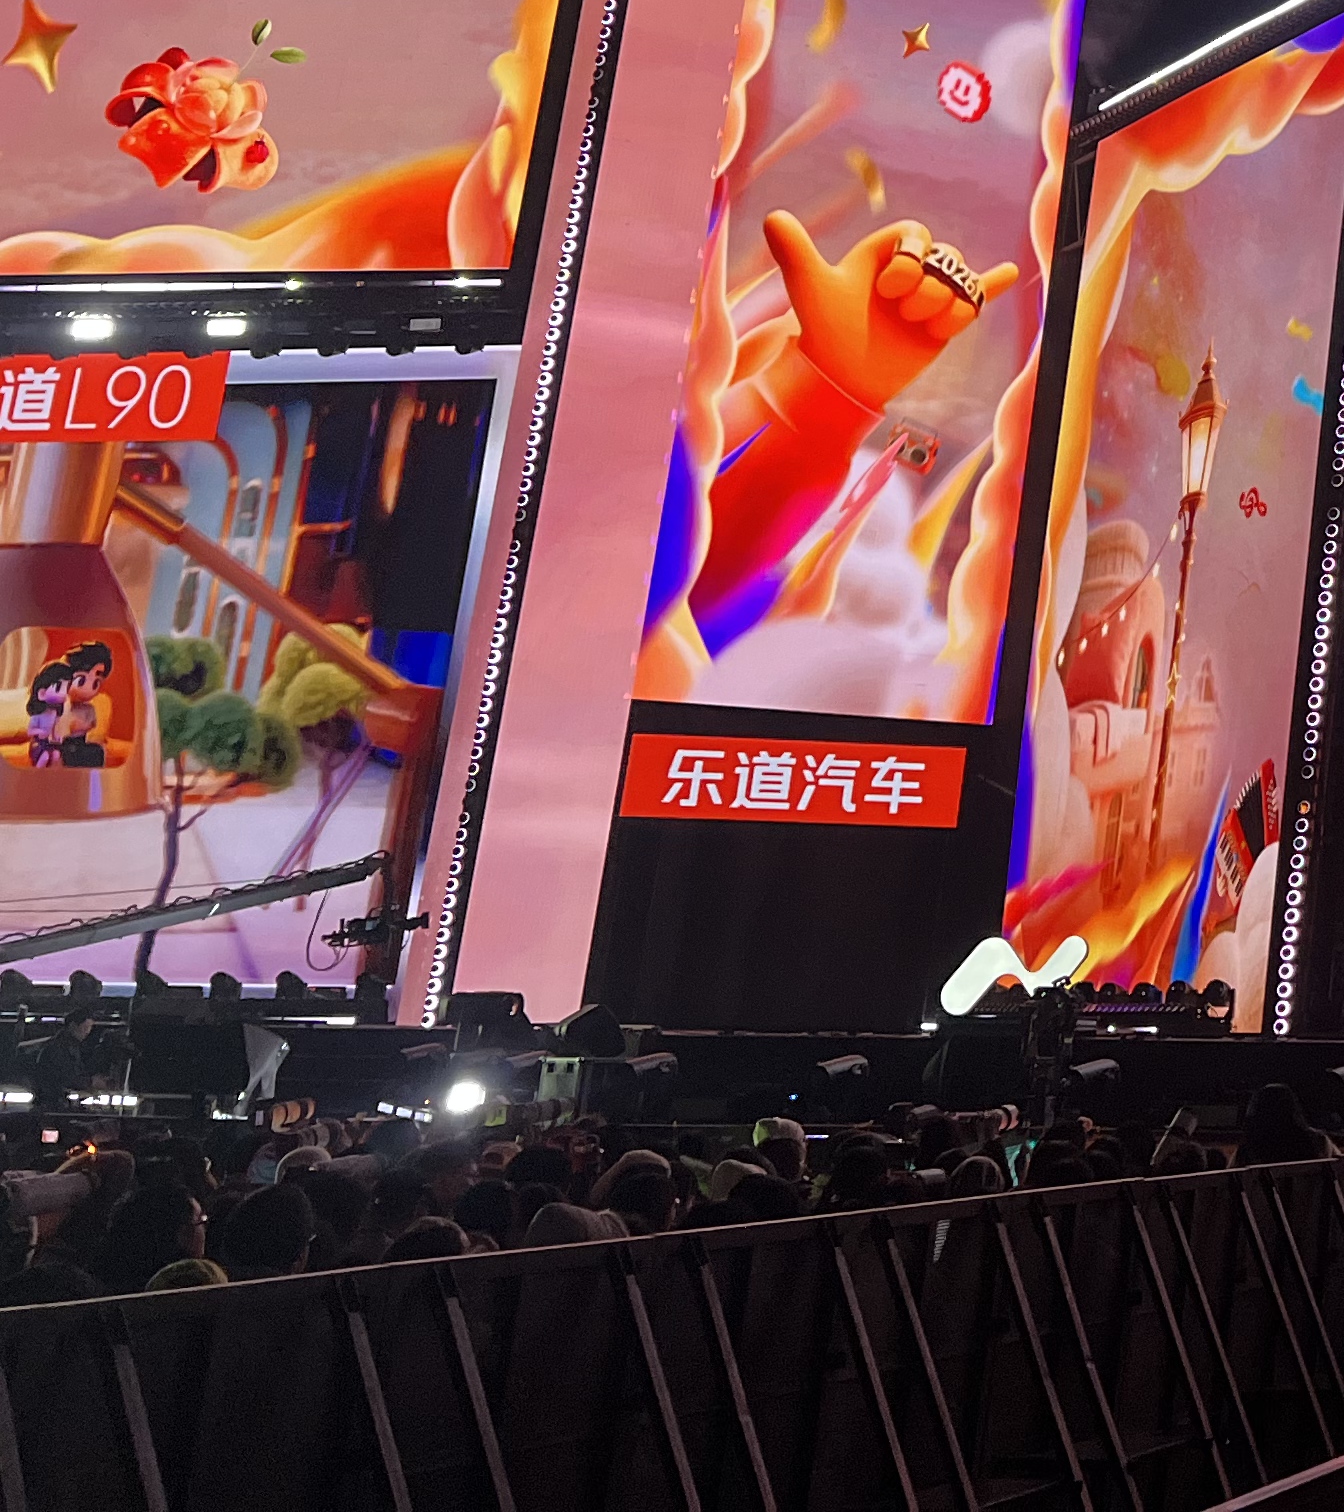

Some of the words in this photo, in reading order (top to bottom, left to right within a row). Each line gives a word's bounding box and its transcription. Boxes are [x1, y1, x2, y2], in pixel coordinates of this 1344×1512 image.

[925, 248, 978, 298] 2026
[0, 365, 191, 431] 道L90
[661, 749, 926, 815] 乐道汽车
